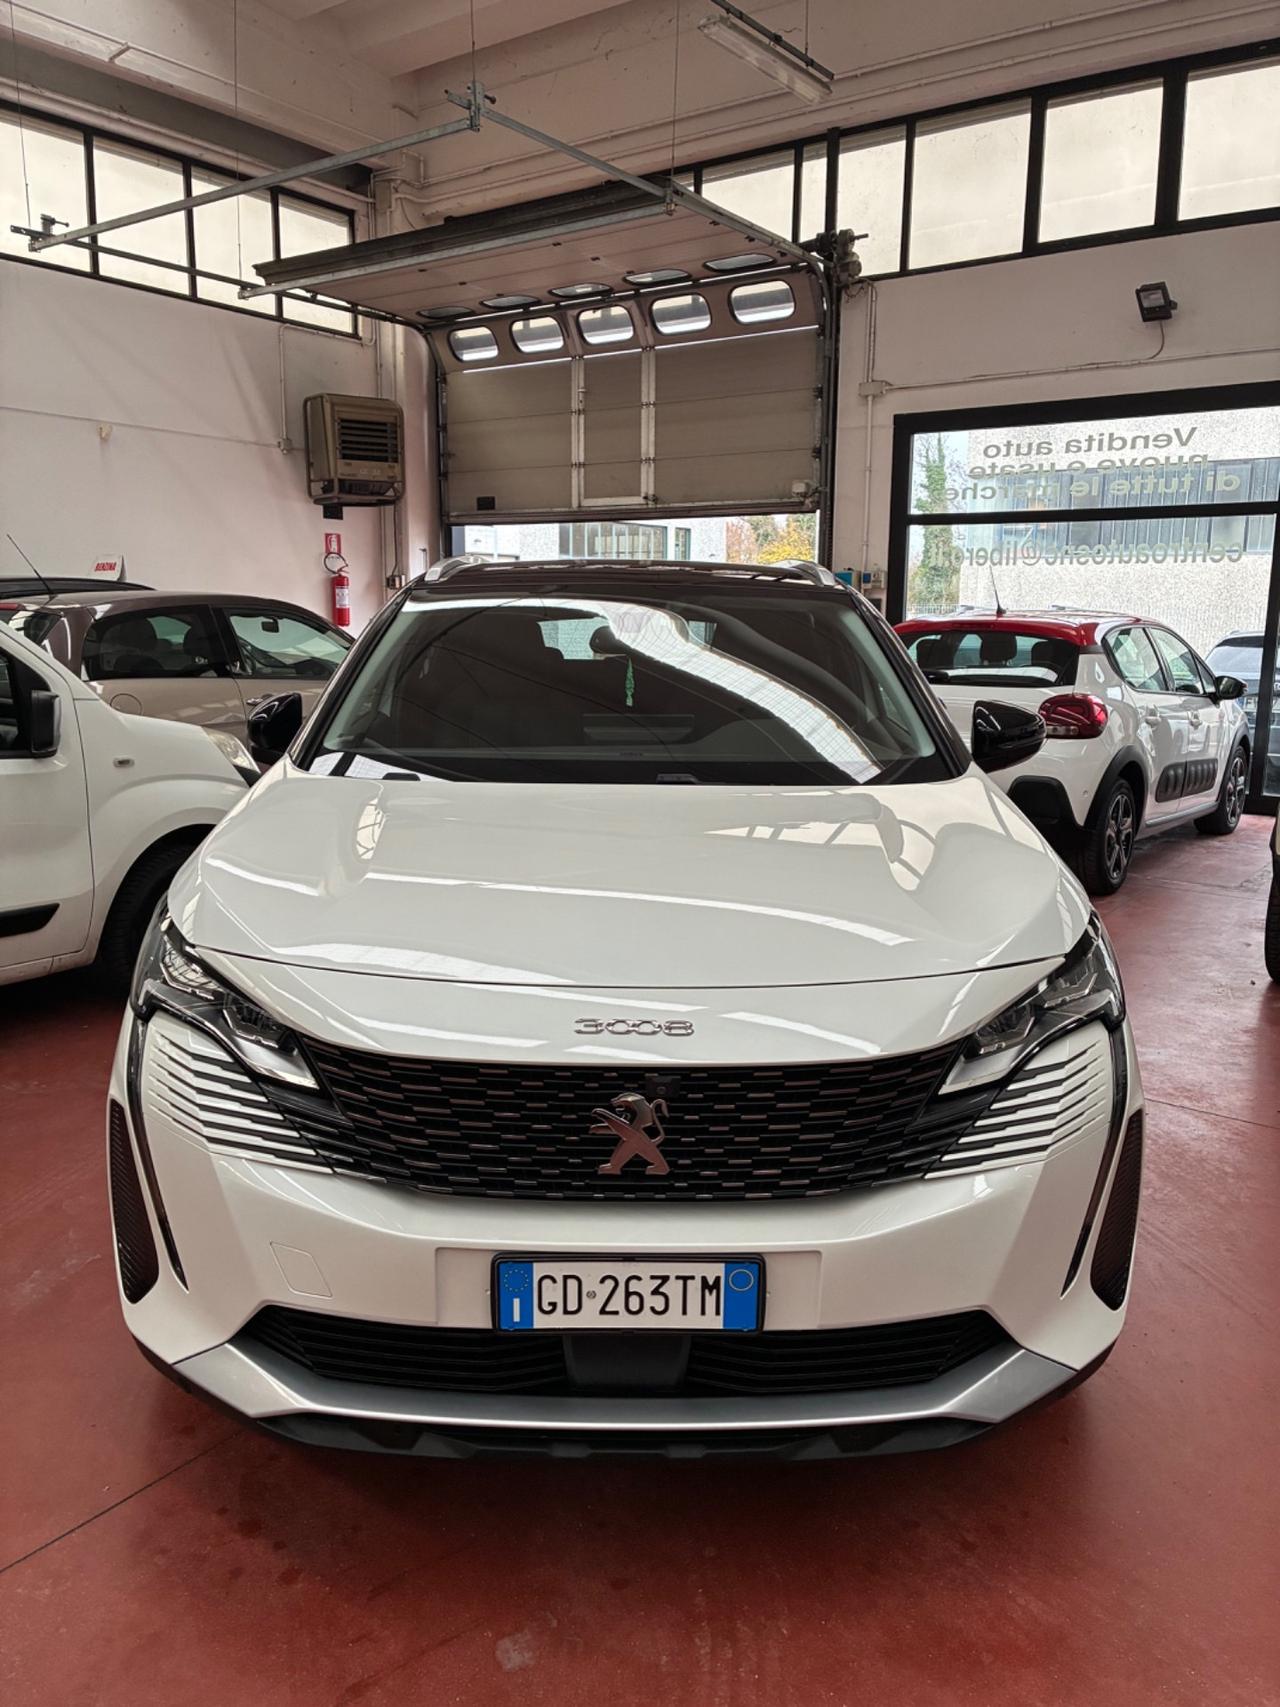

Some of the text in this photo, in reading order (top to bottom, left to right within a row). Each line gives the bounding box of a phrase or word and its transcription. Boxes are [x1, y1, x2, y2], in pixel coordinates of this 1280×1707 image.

[573, 1018, 695, 1036] 3008
[536, 1274, 722, 1316] GD 263TM
